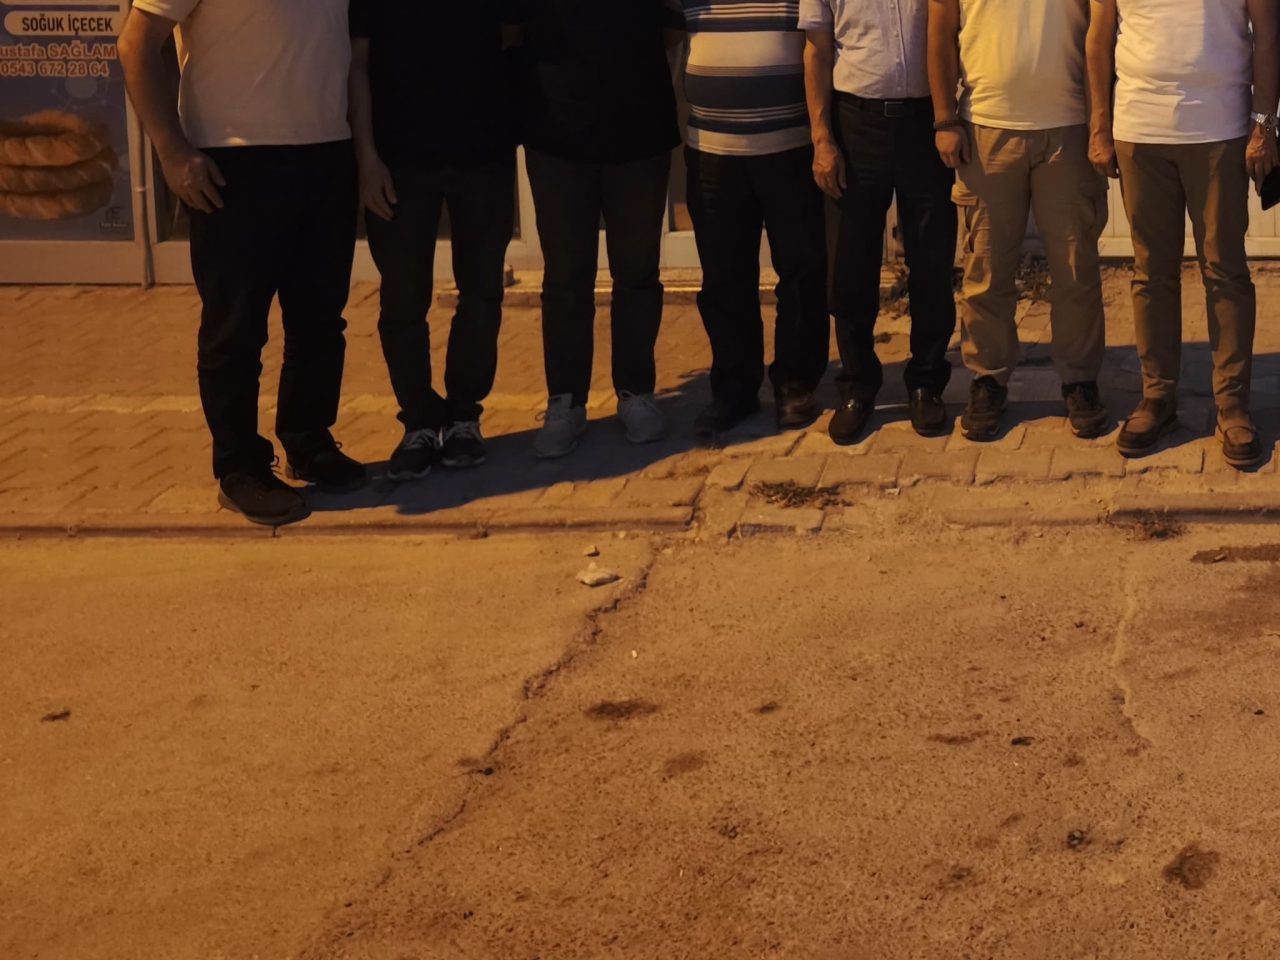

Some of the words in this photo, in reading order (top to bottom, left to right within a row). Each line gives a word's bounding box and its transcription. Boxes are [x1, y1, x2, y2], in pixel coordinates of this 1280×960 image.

[22, 14, 64, 32] SOĞUK
[68, 14, 113, 35] İÇECEK
[48, 40, 117, 59] SAĞLAM
[1, 61, 36, 76] 0543
[38, 61, 65, 76] 672
[68, 61, 89, 75] 28
[90, 61, 110, 75] 64
